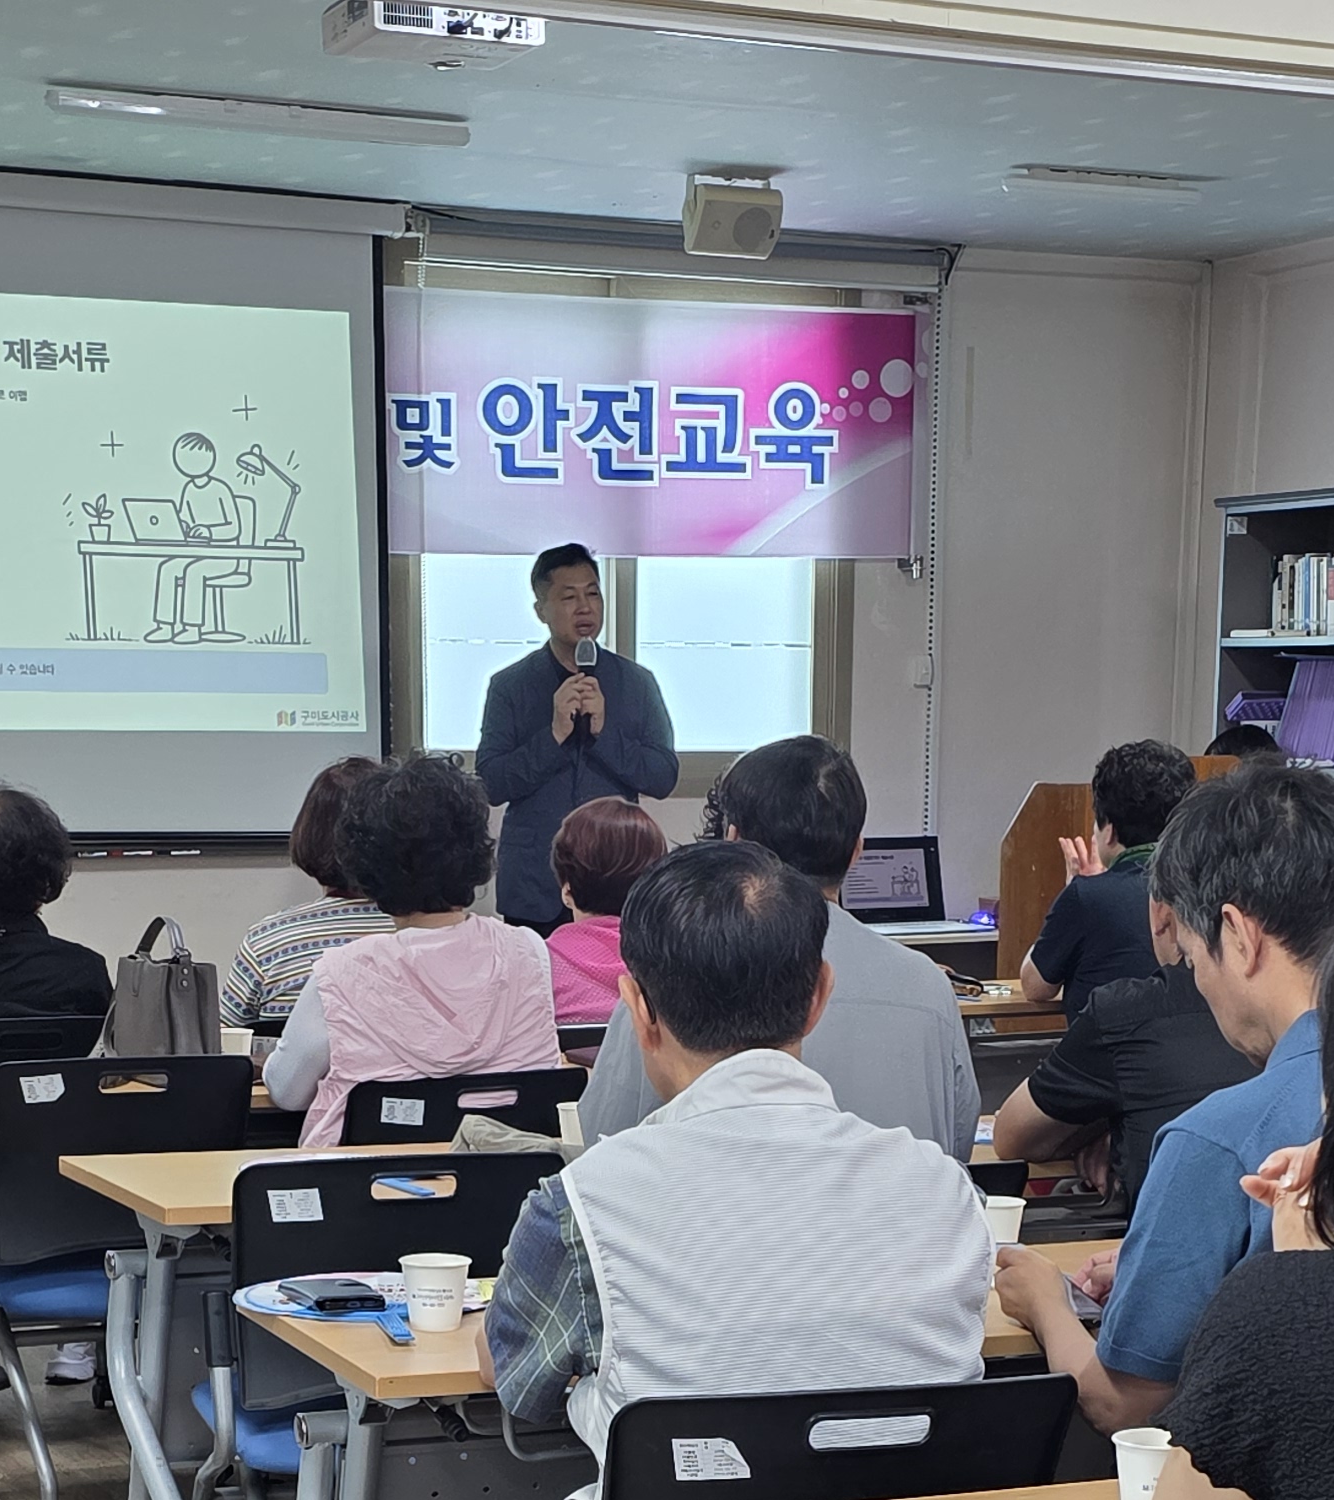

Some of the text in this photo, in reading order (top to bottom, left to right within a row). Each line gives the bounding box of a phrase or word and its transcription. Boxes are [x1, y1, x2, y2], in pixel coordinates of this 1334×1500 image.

[2, 338, 110, 373] 제출서류
[389, 396, 457, 471] 및
[480, 380, 836, 487] 안전교육
[6, 663, 16, 675] 수
[300, 710, 360, 722] 구미도시공사
